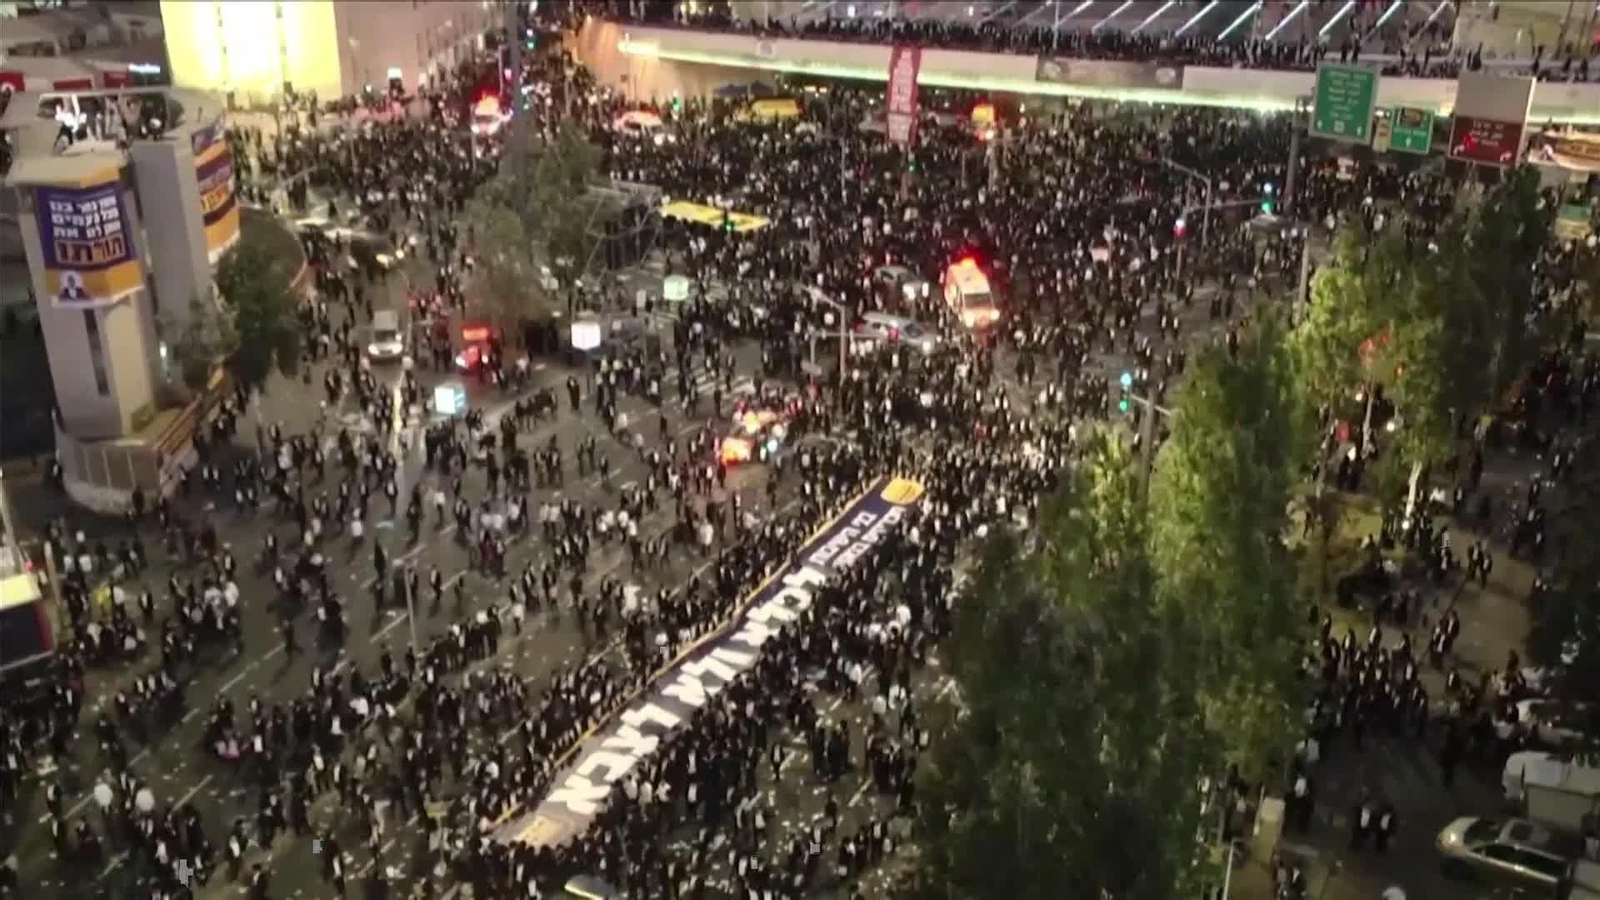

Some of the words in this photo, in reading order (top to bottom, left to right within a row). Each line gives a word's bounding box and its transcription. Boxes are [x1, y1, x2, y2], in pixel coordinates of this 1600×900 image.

[730, 567, 826, 647] לכלא
[661, 647, 758, 707] ולא
[546, 703, 681, 815] לצבא
